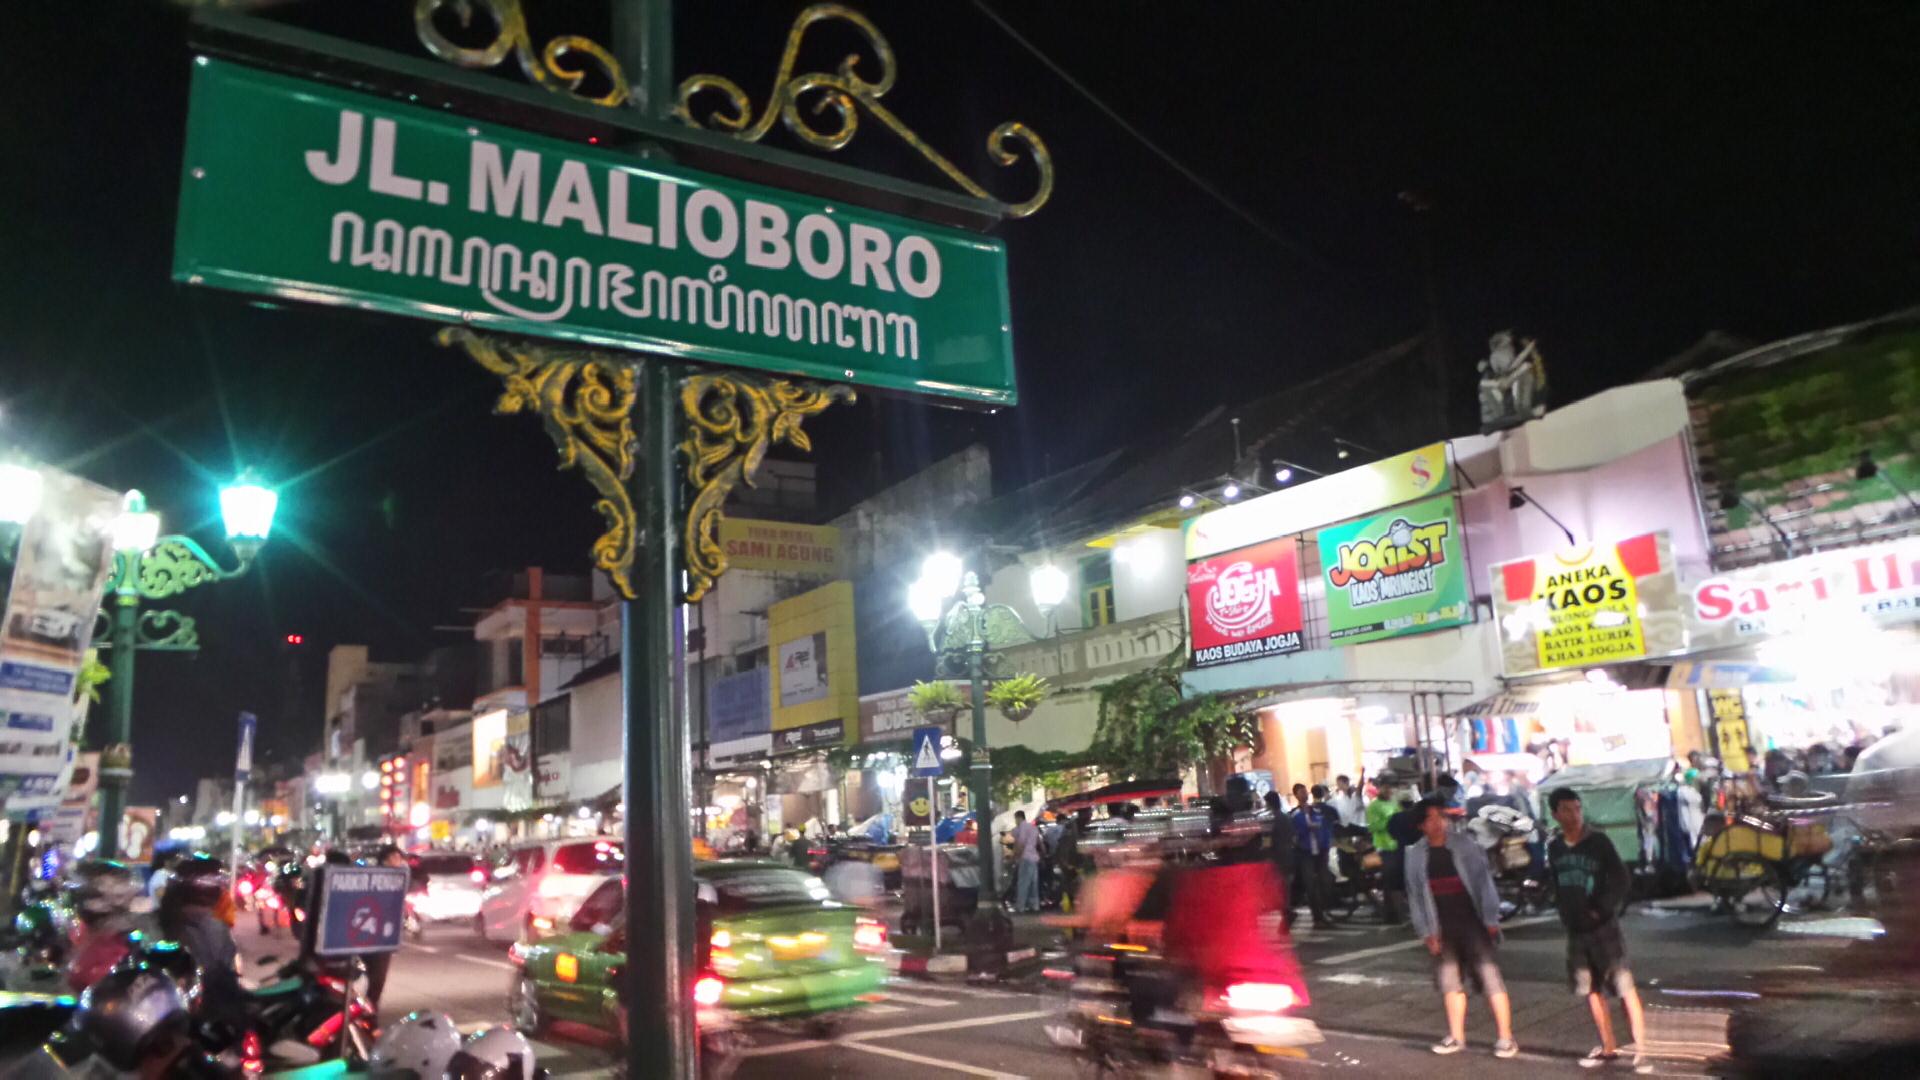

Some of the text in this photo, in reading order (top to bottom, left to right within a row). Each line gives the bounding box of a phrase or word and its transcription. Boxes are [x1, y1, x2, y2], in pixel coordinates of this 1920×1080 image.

[304, 110, 942, 299] JL. MALIOBORO
[726, 539, 834, 563] SAMI AGUNG
[1330, 521, 1448, 587] JOGIST
[1547, 565, 1611, 588] ANEKA
[1852, 553, 1920, 595] Il
[1213, 567, 1281, 610] JOGJA
[1350, 580, 1379, 607] KAOS
[1543, 625, 1582, 638] KAOS
[1545, 630, 1633, 651] BATIK LURIK
[1196, 646, 1223, 662] KAOS
[1224, 639, 1264, 658] BUDAYA
[1264, 632, 1300, 650] JOGJA
[1547, 642, 1635, 662] KHAS JOGJA
